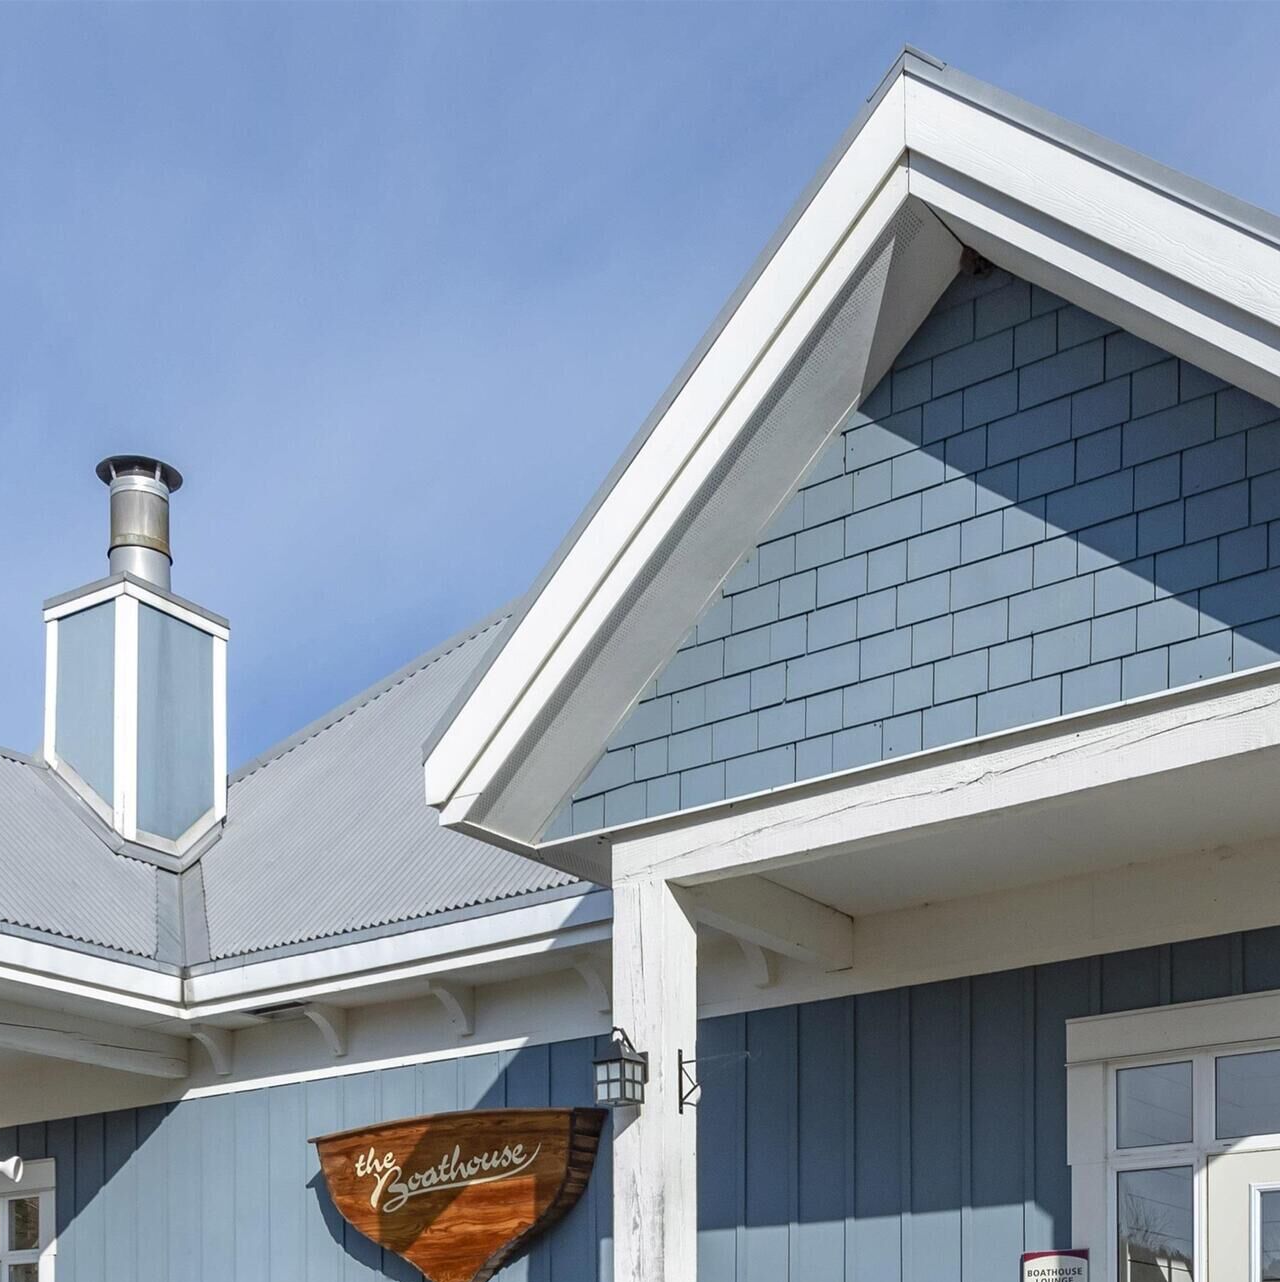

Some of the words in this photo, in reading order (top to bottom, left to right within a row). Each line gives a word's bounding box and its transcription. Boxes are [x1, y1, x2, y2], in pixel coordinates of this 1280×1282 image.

[355, 1147, 397, 1177] the
[370, 1142, 542, 1213] Boathouse
[1027, 1267, 1083, 1277] BOATHOUSE
